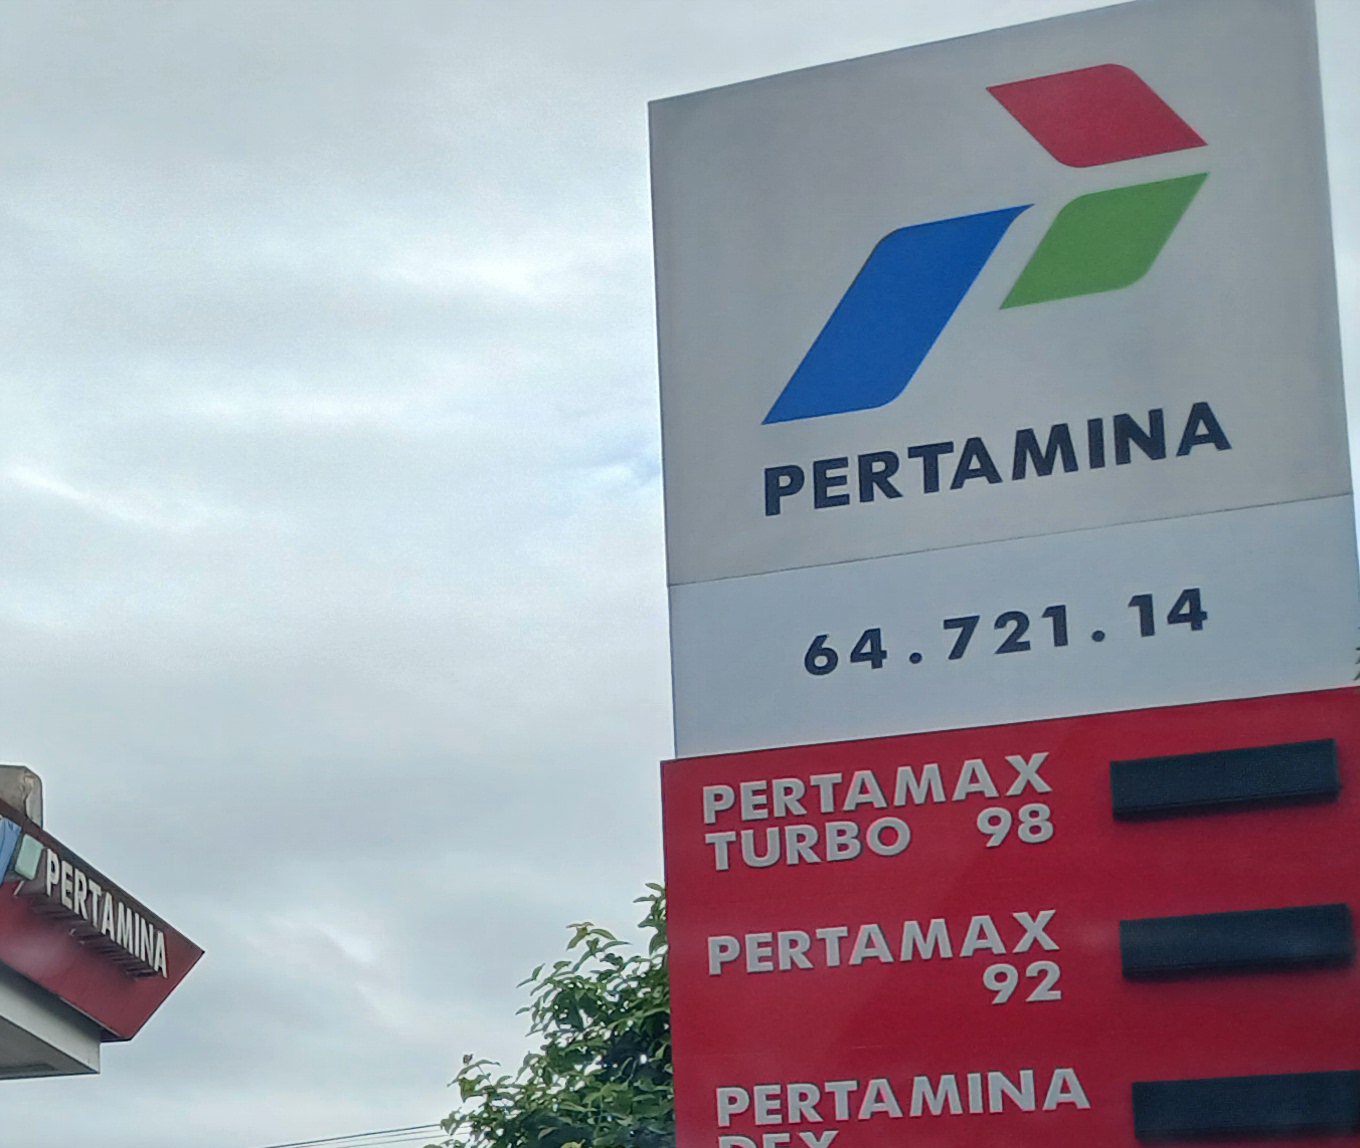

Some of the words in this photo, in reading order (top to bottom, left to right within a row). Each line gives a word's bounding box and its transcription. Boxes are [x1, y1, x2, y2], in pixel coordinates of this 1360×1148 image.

[764, 401, 1231, 516] PERTAMINA
[702, 752, 1053, 824] PERTAMAX
[705, 817, 911, 870] TURBO
[976, 804, 1054, 847] 98
[45, 848, 168, 979] PERTAMINA
[707, 910, 1060, 975] PERTAMAX
[982, 961, 1062, 1005] 92
[715, 1067, 1091, 1127] PERTAMINA
